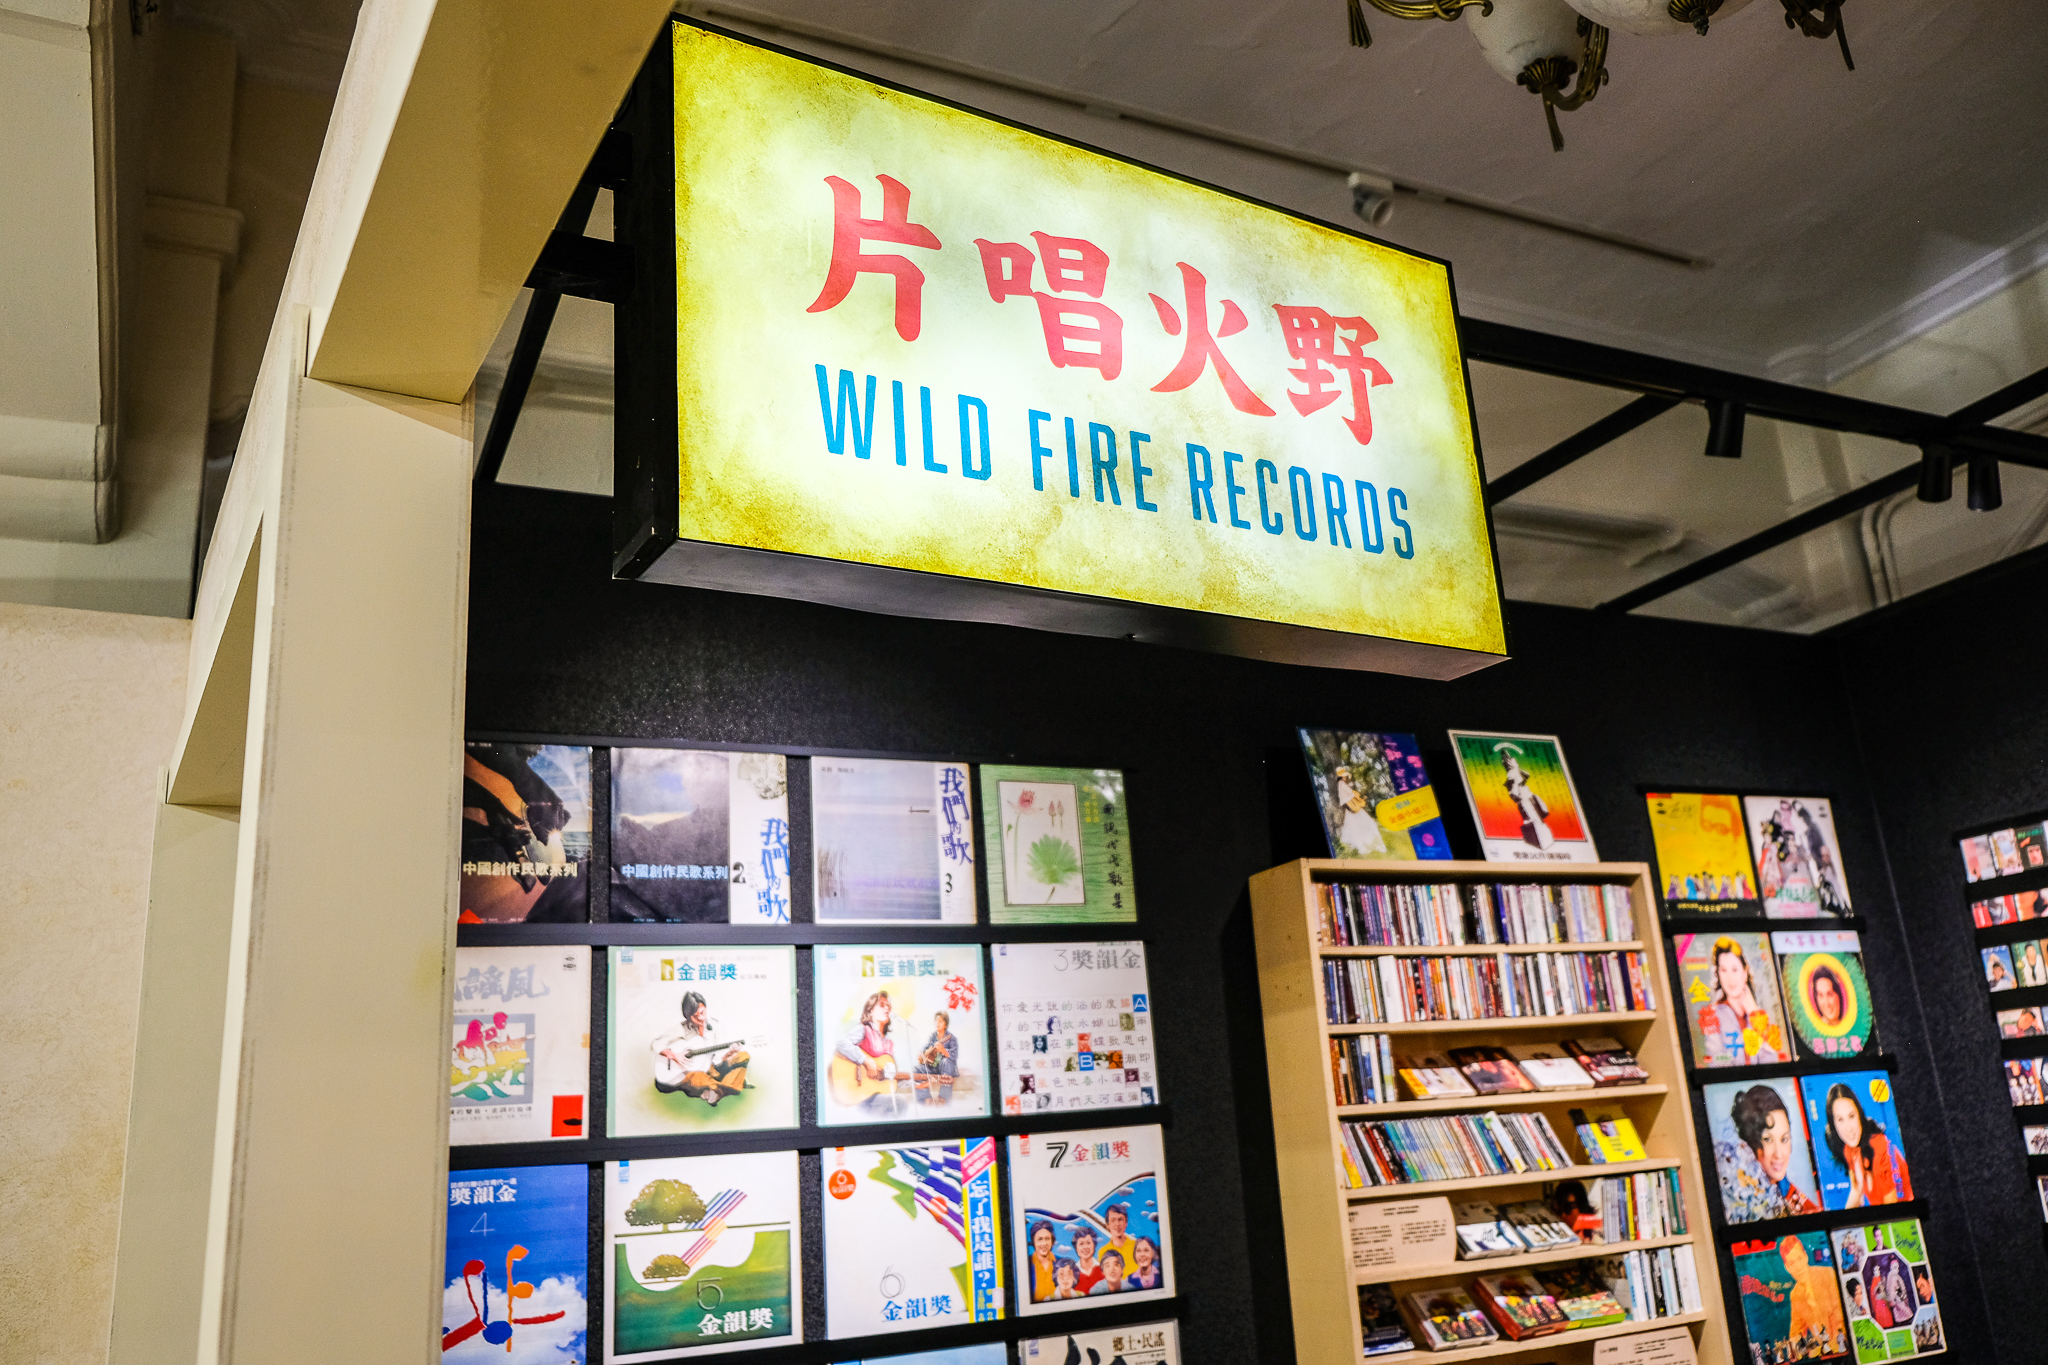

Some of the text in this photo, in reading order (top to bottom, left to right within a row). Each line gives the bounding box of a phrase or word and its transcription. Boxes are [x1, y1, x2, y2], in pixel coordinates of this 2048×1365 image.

[815, 363, 1416, 561] WILD FIRE RECORDS
[939, 767, 973, 866] 我們的歌
[462, 861, 578, 878] 中國創作民歌系列
[621, 863, 728, 880] 中國創作民歌系列
[732, 861, 746, 884] 2
[758, 817, 790, 924] 我們的歌
[944, 873, 953, 894] 3
[677, 963, 737, 981] 金韻獎
[878, 959, 936, 977] 金韻獎
[1054, 949, 1069, 972] 3
[455, 964, 550, 1003] 謠風
[1135, 998, 1147, 1010] A
[1081, 1055, 1093, 1068] B
[1046, 1141, 1069, 1168] 7
[1072, 1141, 1131, 1162] 金韻獎
[836, 1170, 847, 1185] 6
[470, 1212, 495, 1237] 4
[880, 1265, 905, 1299] 6
[696, 1277, 724, 1311] 5
[880, 1295, 952, 1323] 金韻獎
[697, 1307, 774, 1337] 金韻獎
